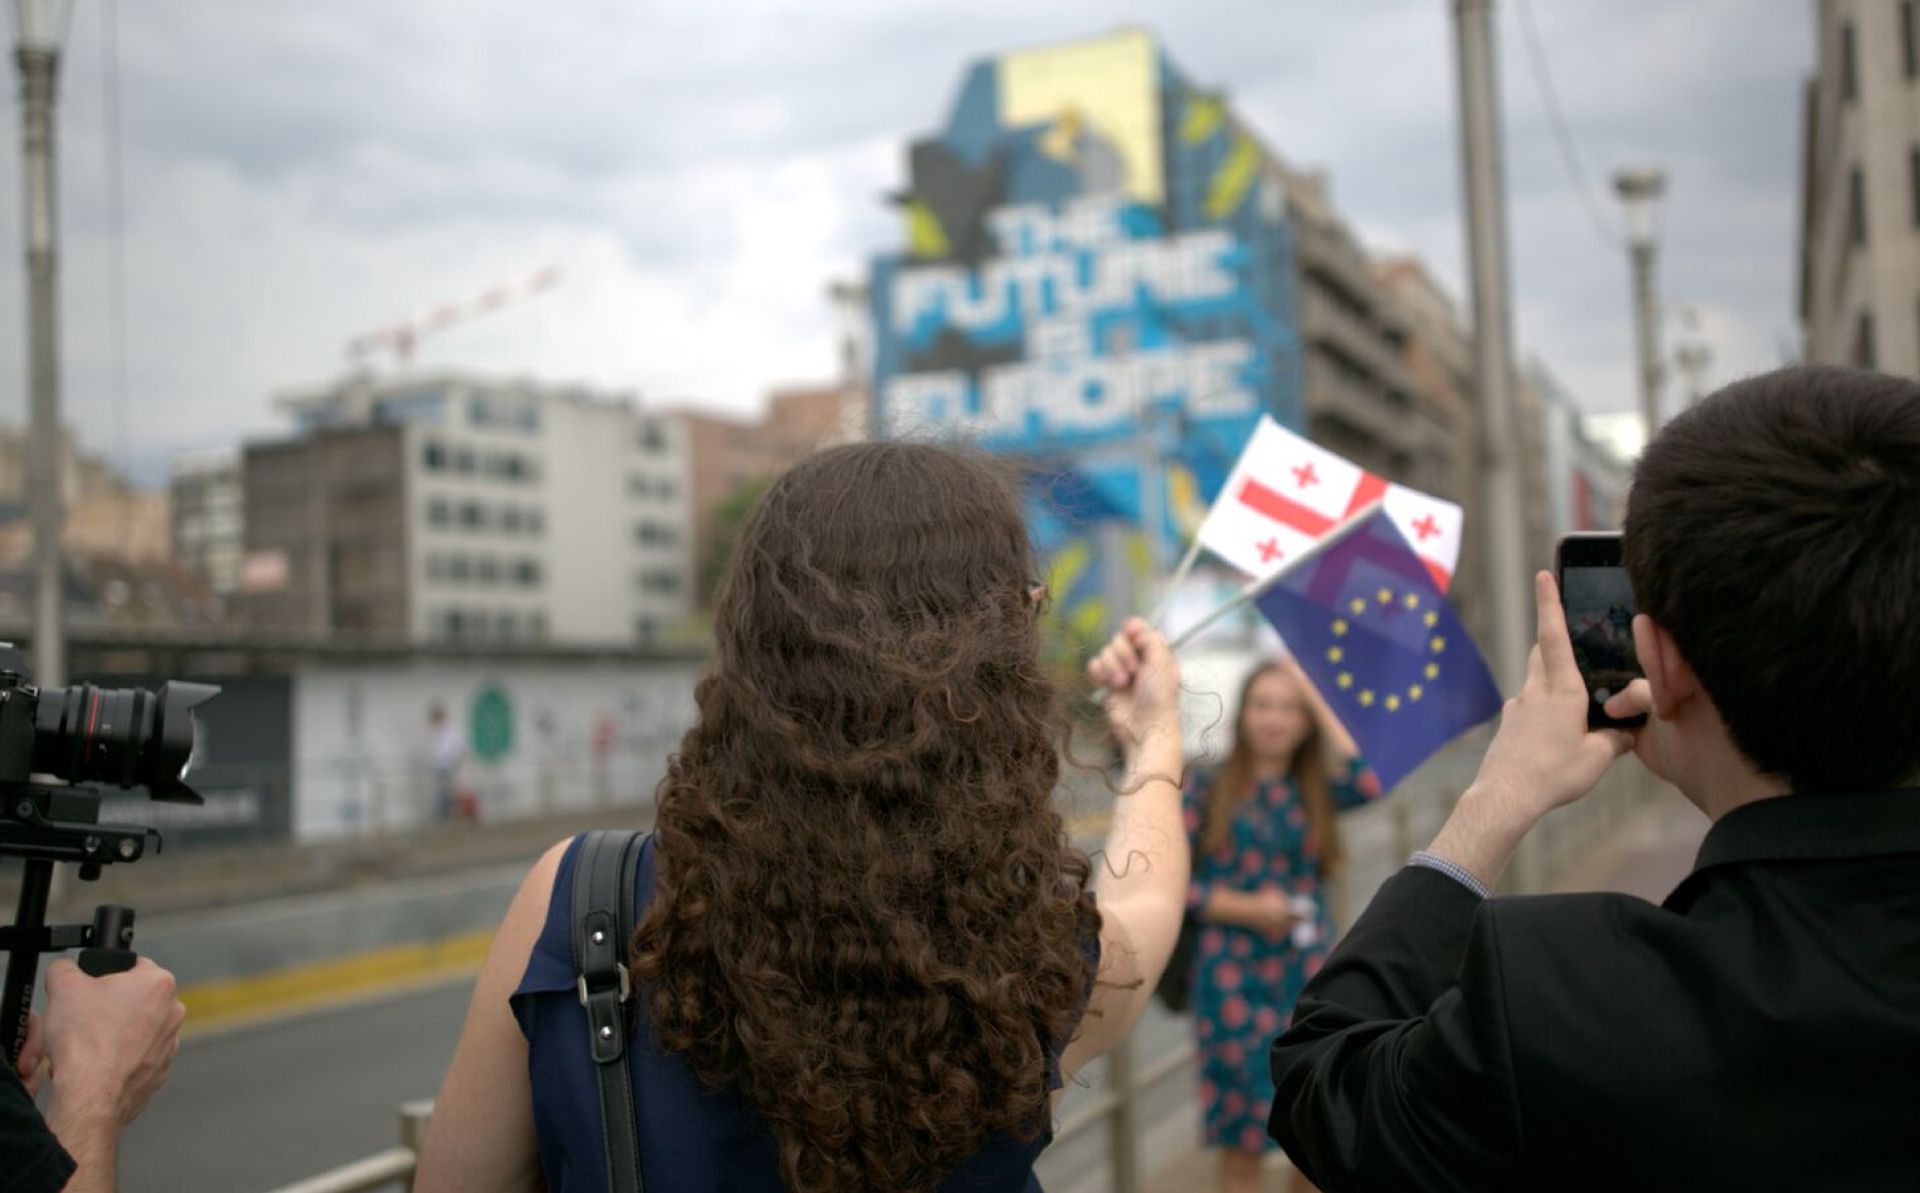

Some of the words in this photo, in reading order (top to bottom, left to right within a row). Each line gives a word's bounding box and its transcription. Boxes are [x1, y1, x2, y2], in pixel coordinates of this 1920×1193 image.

[987, 197, 1130, 258] THE
[891, 232, 1239, 334] FUTURE
[885, 342, 1261, 438] EUROPE
